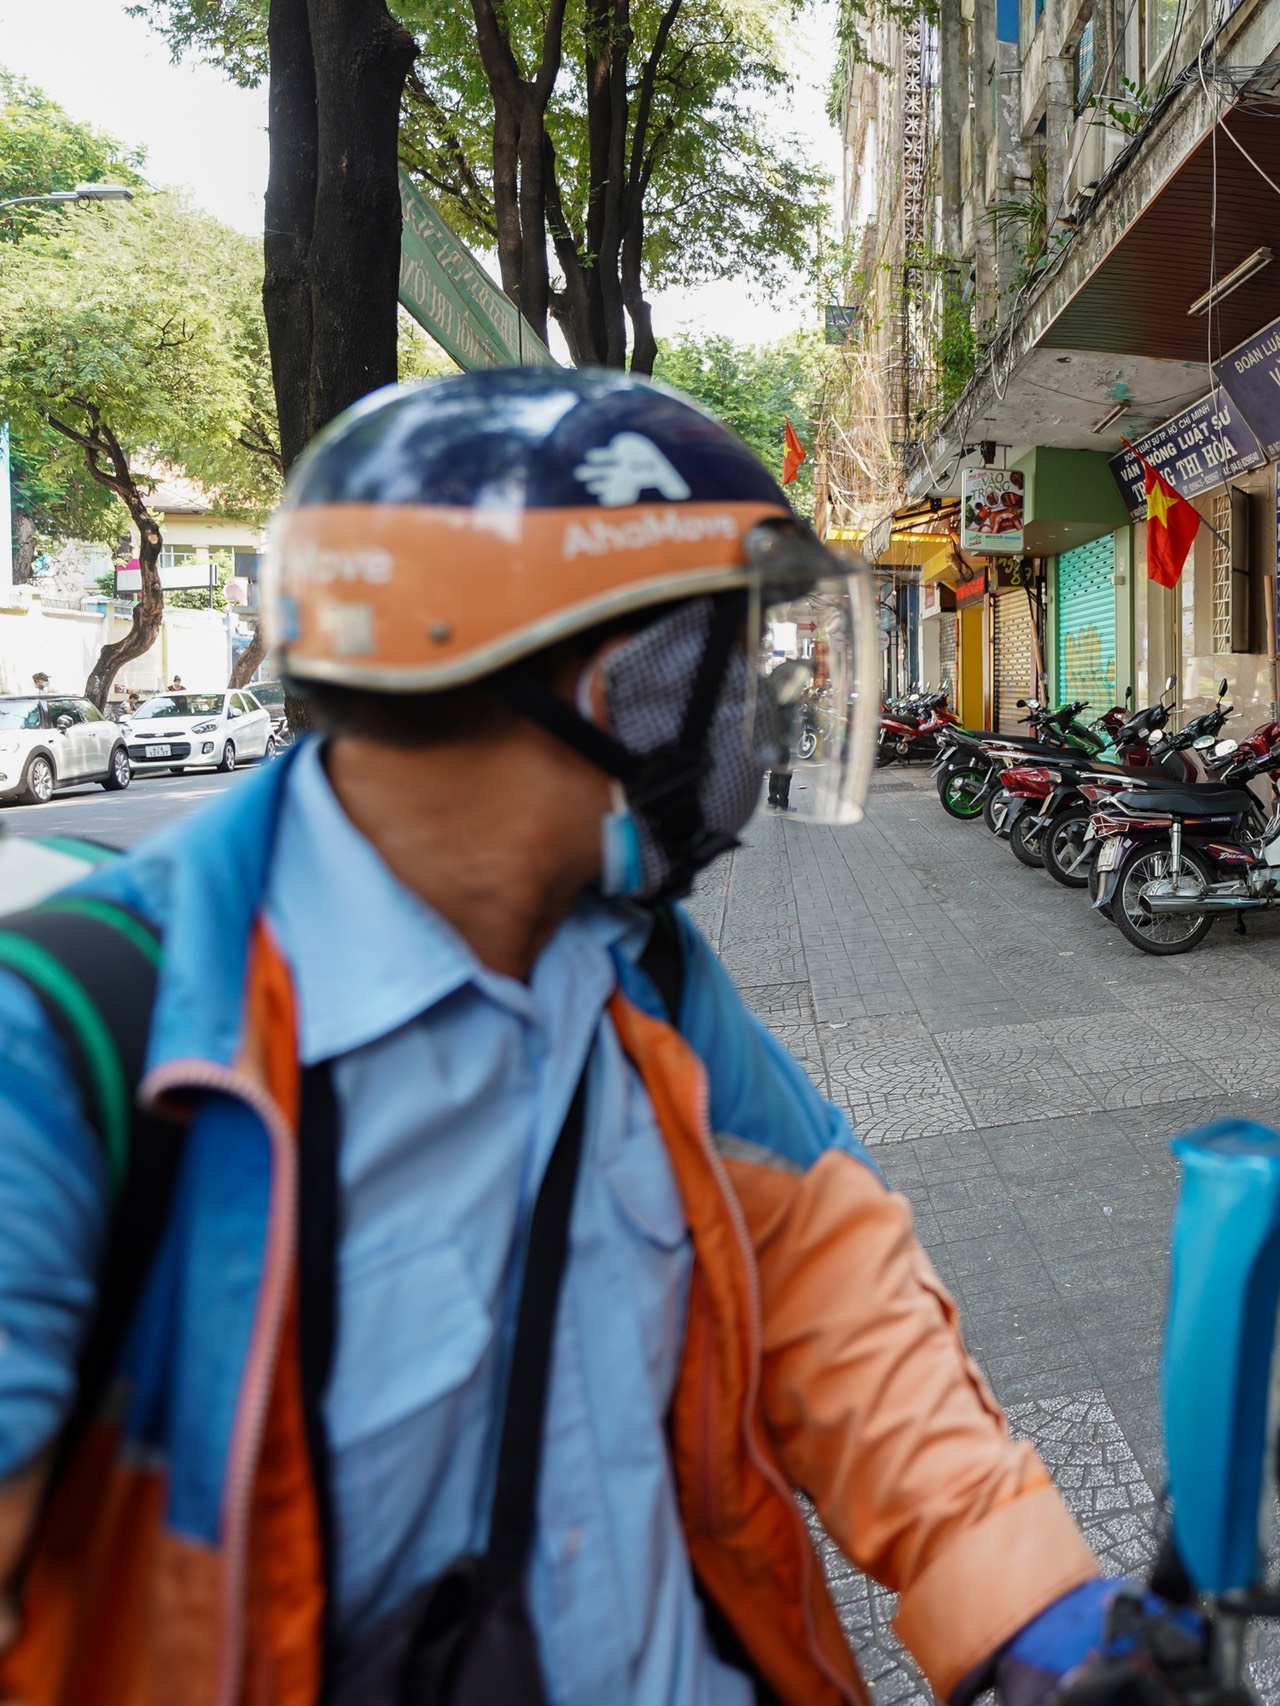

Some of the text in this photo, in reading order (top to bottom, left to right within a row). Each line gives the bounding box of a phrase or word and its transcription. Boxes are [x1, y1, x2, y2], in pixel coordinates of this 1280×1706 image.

[1234, 348, 1263, 374] ĐOÀN
[1177, 421, 1209, 450] LUẬT
[1176, 453, 1204, 480] THỊ
[982, 473, 1004, 487] VÀO
